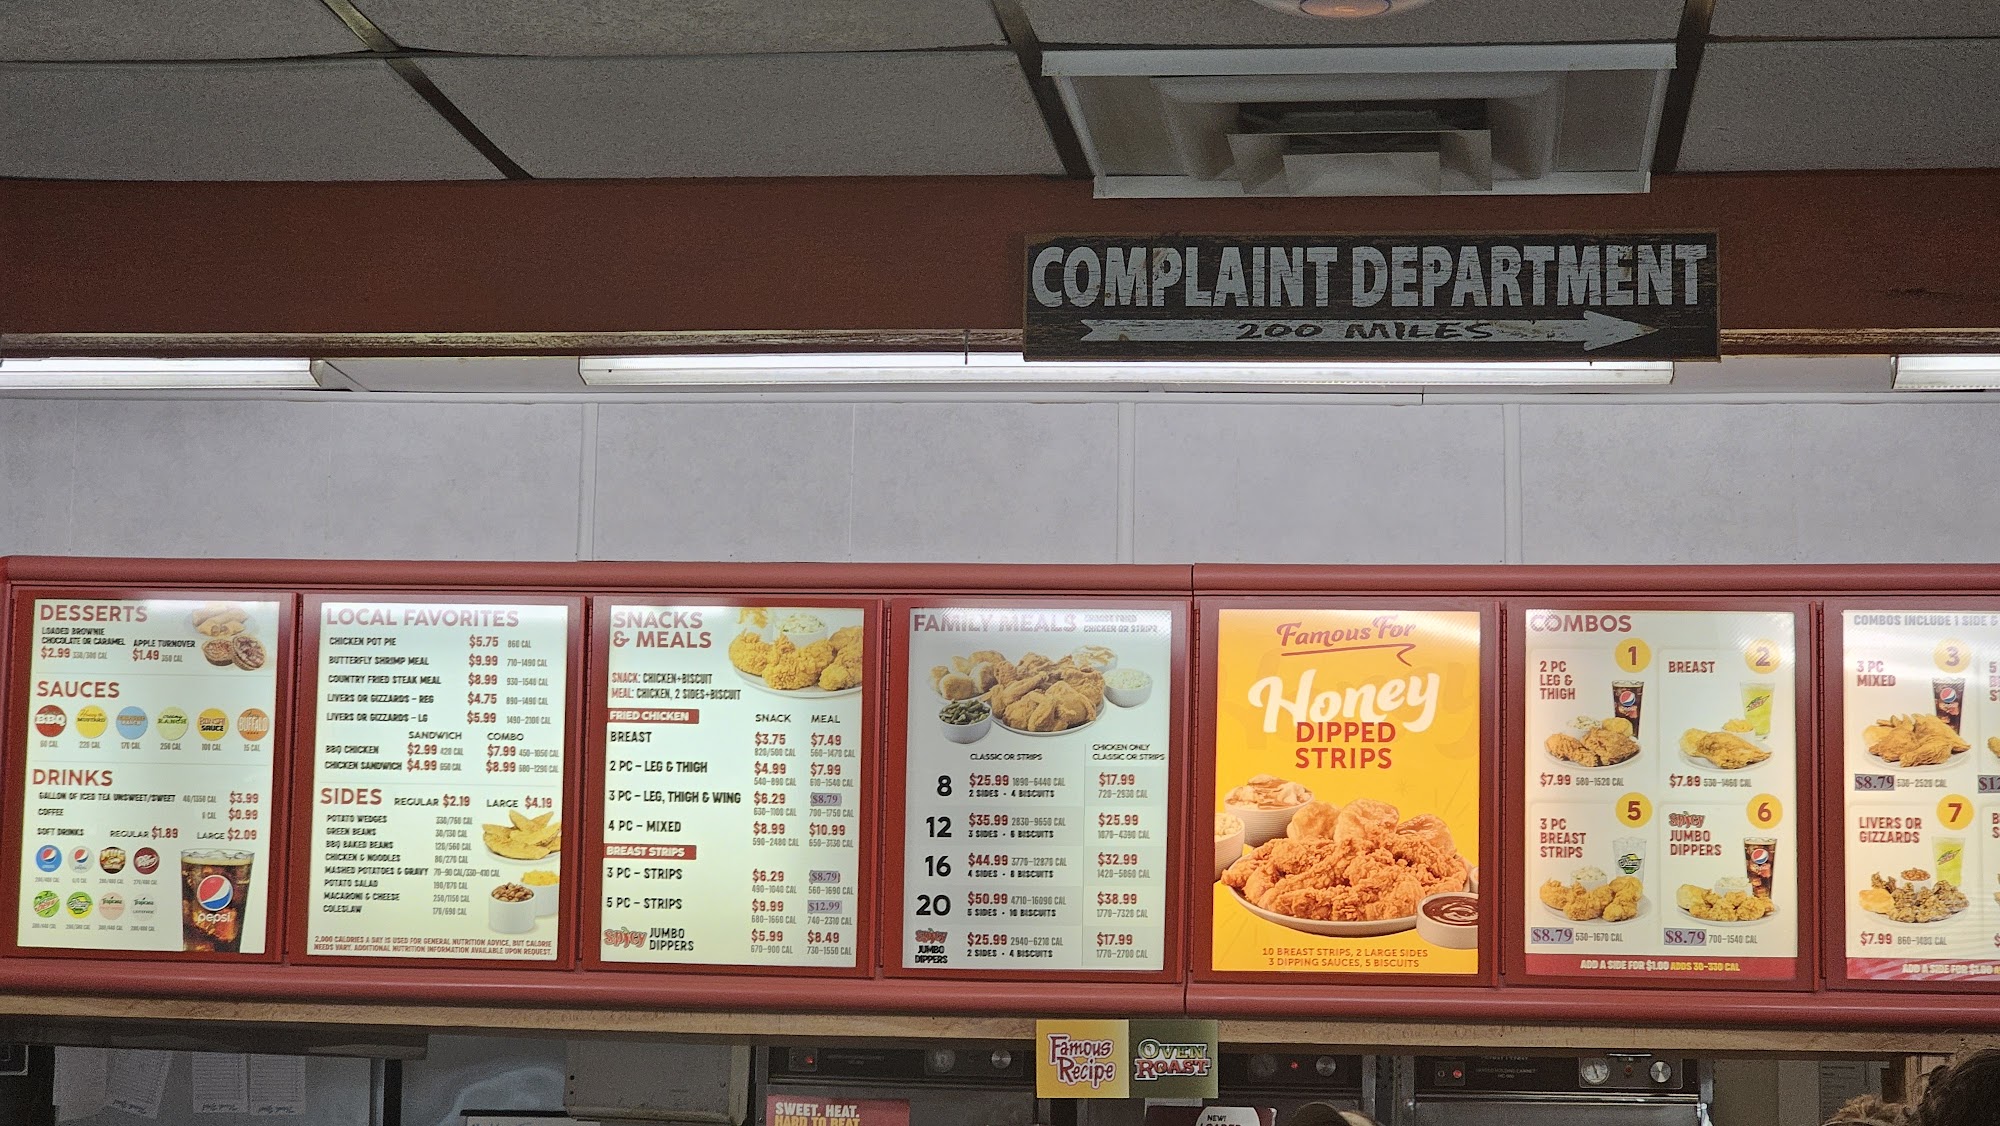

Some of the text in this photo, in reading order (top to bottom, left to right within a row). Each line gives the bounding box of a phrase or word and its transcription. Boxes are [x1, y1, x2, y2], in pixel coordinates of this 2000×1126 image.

[1032, 245, 1707, 307] COMPLAINT DEPARTMENT
[1236, 322, 1493, 340] 200 MILES
[40, 605, 148, 622] DESSERTS
[327, 608, 519, 627] LOCAL FAVORITES
[613, 611, 703, 628] SNACKS
[1854, 615, 1986, 626] COMBOS INCLUDE 1 SIDE
[914, 615, 1077, 631] FAMILY MEALS
[1531, 615, 1632, 632] COMBOS
[1277, 615, 1416, 647] Famous For
[158, 640, 195, 648] TURNOVER
[329, 637, 364, 645] CHICKEN
[385, 638, 396, 646] PIE
[469, 634, 498, 648] $5.75
[613, 631, 712, 648] & MEALS
[41, 647, 70, 659] $2.99
[133, 650, 159, 662] $1.49
[1628, 646, 1637, 665] 1
[1756, 647, 1770, 666] 2
[1946, 647, 1960, 666] 3
[329, 654, 498, 667] BUTTERFLY SHRIMP MEAL $9.99
[1540, 661, 1566, 672] 2 PC
[1669, 661, 1715, 673] BREAST
[328, 673, 497, 686] COUNTRY FRIED STEAK MEAL $8.99
[612, 673, 712, 684] SNACK: CHICKEN+BISCUIT
[1540, 675, 1572, 686] LEG &
[1857, 675, 1896, 686] MIXED
[37, 681, 120, 698] SAUCES
[612, 689, 741, 700] MEAL: CHICKEN, 2 SIDES+BISCUIT
[1540, 689, 1575, 699] THIGH
[1248, 669, 1440, 733] Honey
[610, 711, 689, 721] FRIED CHICKEN
[755, 714, 840, 723] SNACK MEAL
[409, 732, 524, 741] SANDWICH COMBO
[1296, 722, 1395, 742] DIPPED
[610, 732, 841, 747] BREAST $3.75 $7.49
[407, 743, 516, 757] $2.99 $7.99
[1295, 748, 1392, 769] STRIPS
[610, 761, 841, 776] 2 PC LEG & THIGH $4.99 $7.99
[33, 769, 113, 786] DRINKS
[937, 773, 1134, 796] 8 $25.99 $17.99
[1540, 773, 1571, 787] $7.99
[1670, 773, 1700, 788] $7.89
[1856, 776, 1894, 789] $8.79
[229, 791, 258, 804] $3.99
[321, 788, 518, 808] SIDES REGULAR LARGE
[754, 792, 838, 805] $6.29 $8.79
[1627, 801, 1641, 820] 5
[1757, 803, 1772, 822] 6
[1948, 803, 1962, 822] 7
[646, 822, 845, 836] MIXED $10.99
[926, 813, 1008, 837] 12 $35.99
[1859, 817, 1922, 829] LIVERS OR
[110, 827, 257, 841] REGULAR $1.89 LARGE $2.09
[1540, 833, 1586, 844] BREAST
[1670, 830, 1710, 842] JUMBO
[1860, 831, 1920, 843] GIZZARDS
[607, 847, 685, 856] BREAST STRIPS
[1540, 846, 1583, 858] STRIPS
[1670, 844, 1721, 856] DIPPERS
[925, 852, 1137, 876] 16 $44.99 $32.99
[607, 867, 682, 879] 3 PC STRIPS
[809, 901, 839, 911] $12.99
[916, 892, 1137, 915] 20 $50.99 $38.99
[198, 912, 231, 925] pepsi
[649, 928, 839, 944] JUMBO $8.49
[1533, 928, 1572, 942] $8.79
[1665, 929, 1705, 944] $8.79
[1860, 931, 1892, 946] $7.99
[649, 940, 694, 951] DIPPERS
[1263, 948, 1428, 957] 10 BREAST STRIPS, 2 LARGE SIDES
[1277, 958, 1319, 966] DIPPING
[1321, 959, 1363, 968] SAUCES,
[1366, 959, 1371, 967] 5
[1374, 959, 1419, 967] BISCUITS
[1048, 1034, 1113, 1064] Famous
[1139, 1040, 1207, 1059] OVEN
[1058, 1057, 1116, 1088] Recipe
[1135, 1059, 1211, 1080] ROAST
[775, 1102, 859, 1118] SWEET. HEAT.
